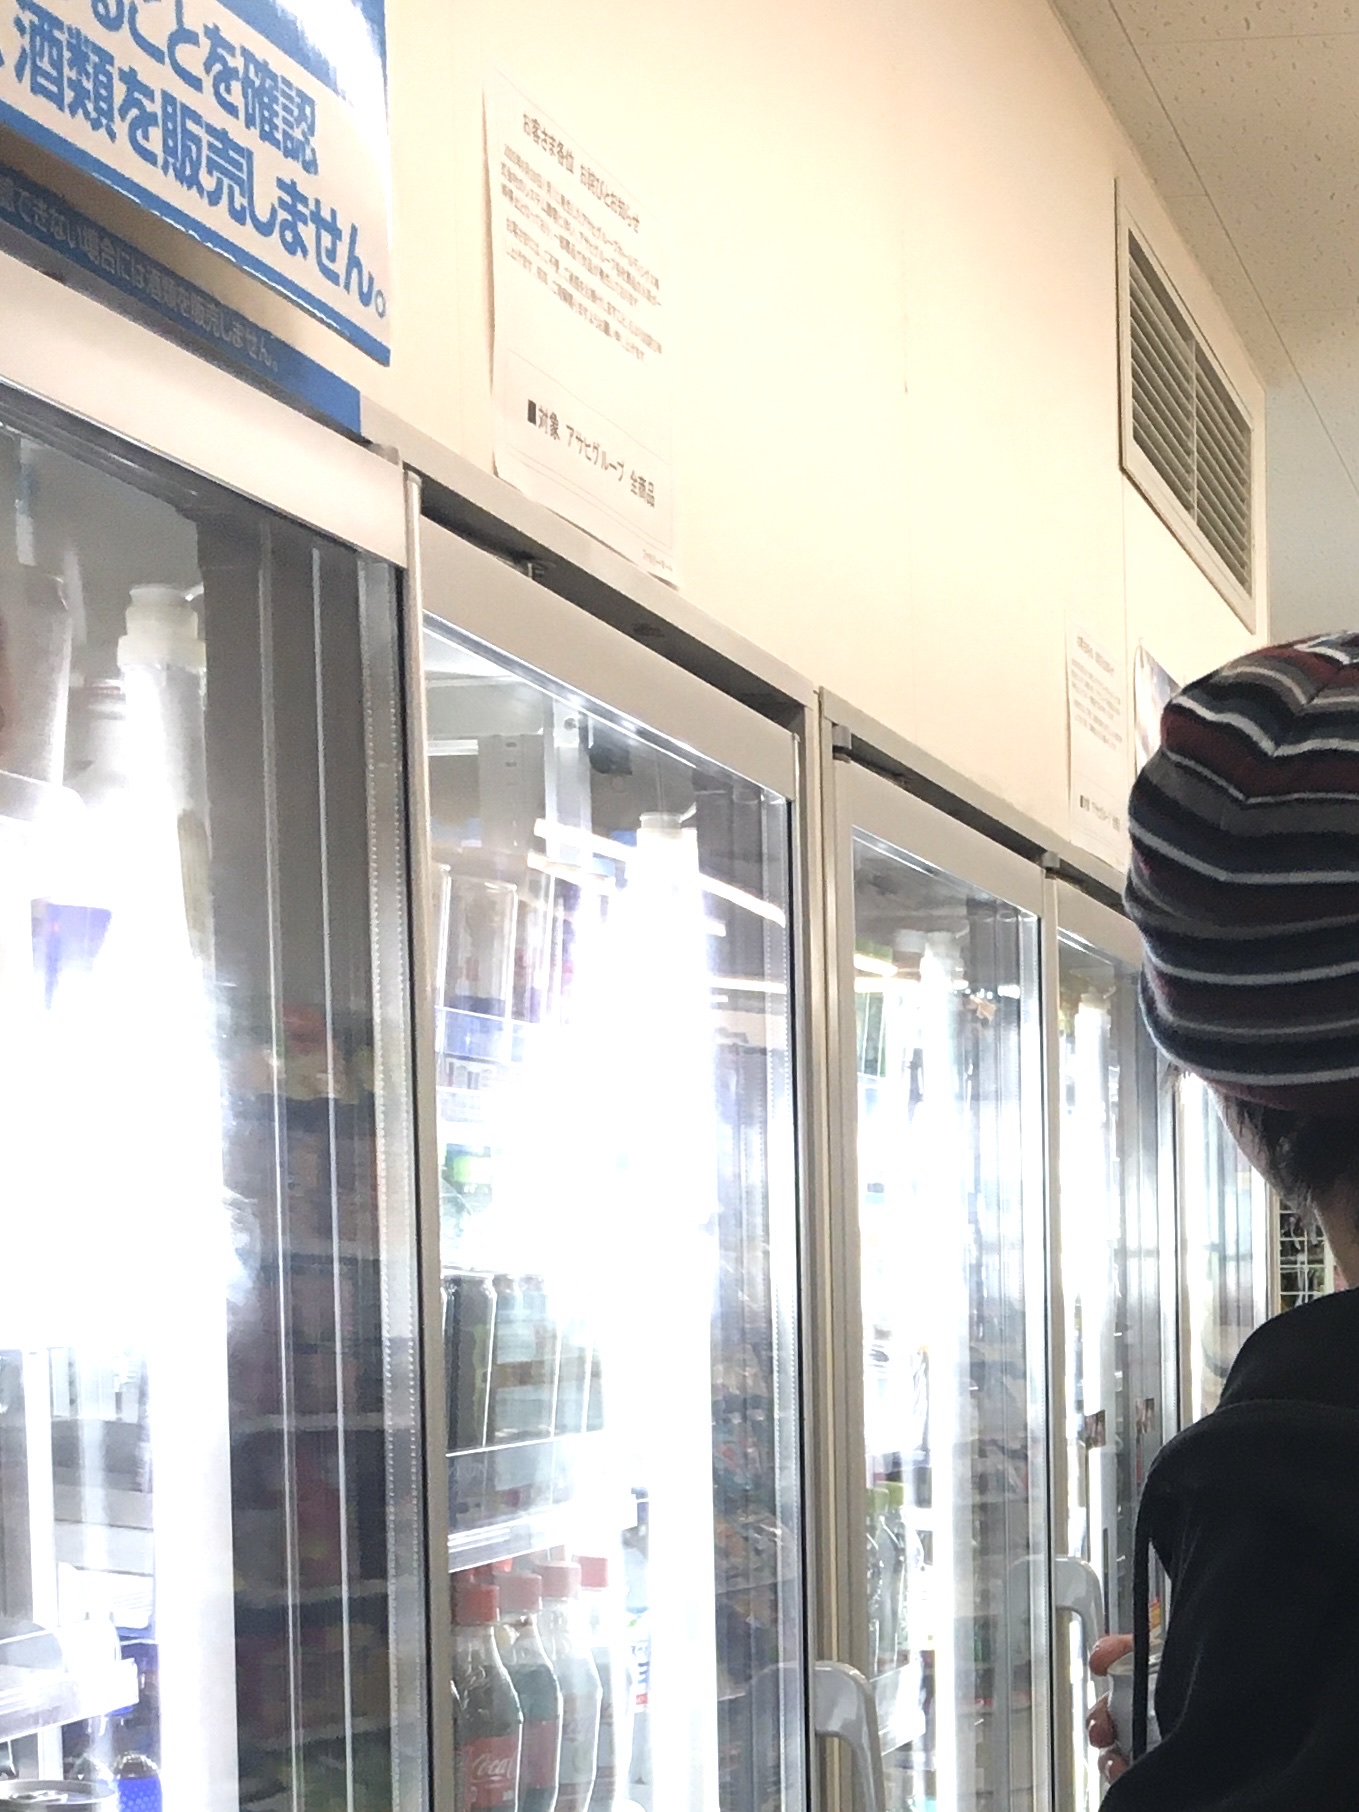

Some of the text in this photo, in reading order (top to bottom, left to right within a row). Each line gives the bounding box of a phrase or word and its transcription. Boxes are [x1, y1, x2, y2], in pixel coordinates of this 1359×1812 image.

[13, 0, 386, 318] 酒類を販売しません。
